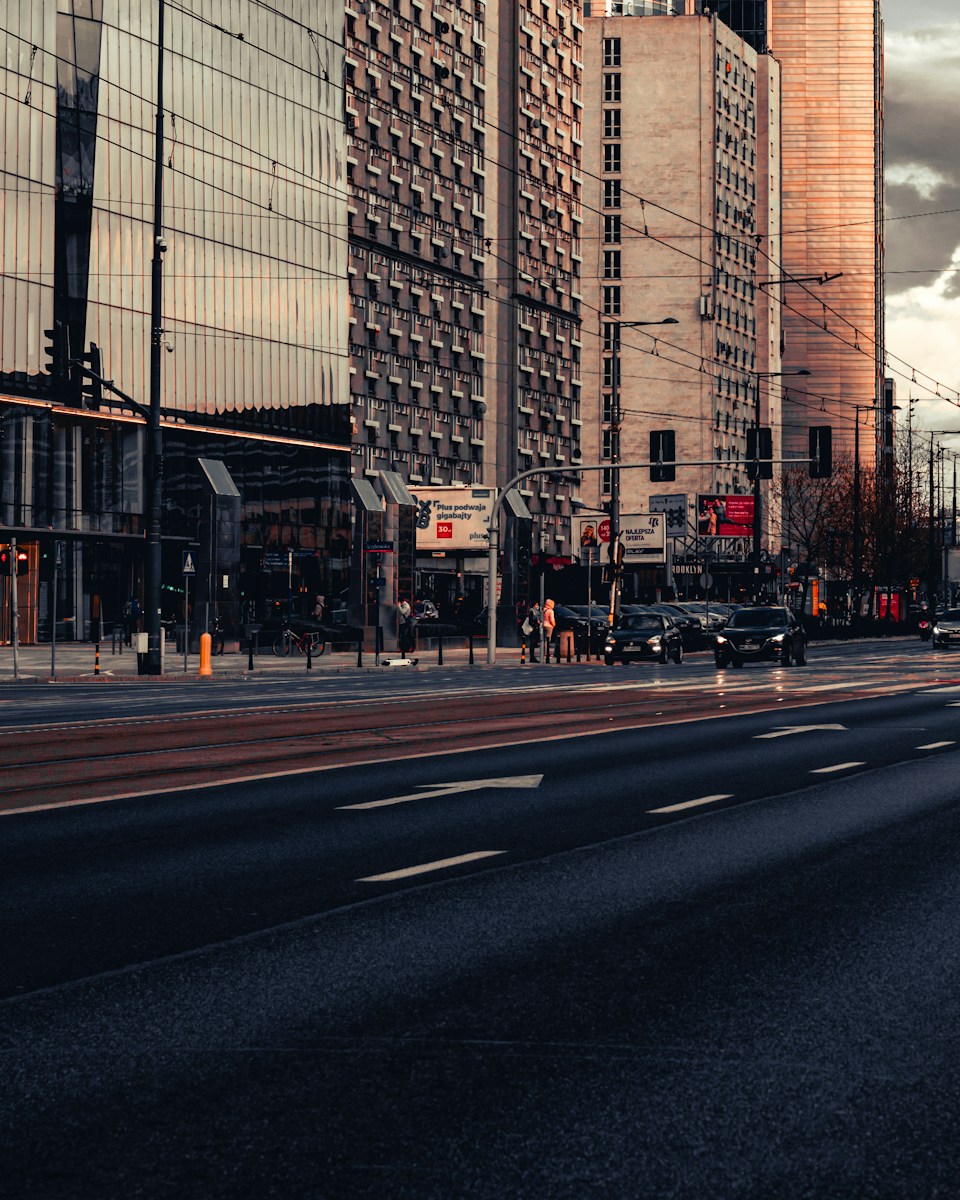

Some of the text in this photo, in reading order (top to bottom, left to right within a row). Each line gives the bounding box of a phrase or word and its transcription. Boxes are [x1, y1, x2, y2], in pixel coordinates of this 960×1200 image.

[454, 504, 486, 512] podwaja
[437, 512, 472, 520] gigabajty
[672, 565, 702, 574] ROOKLYN
